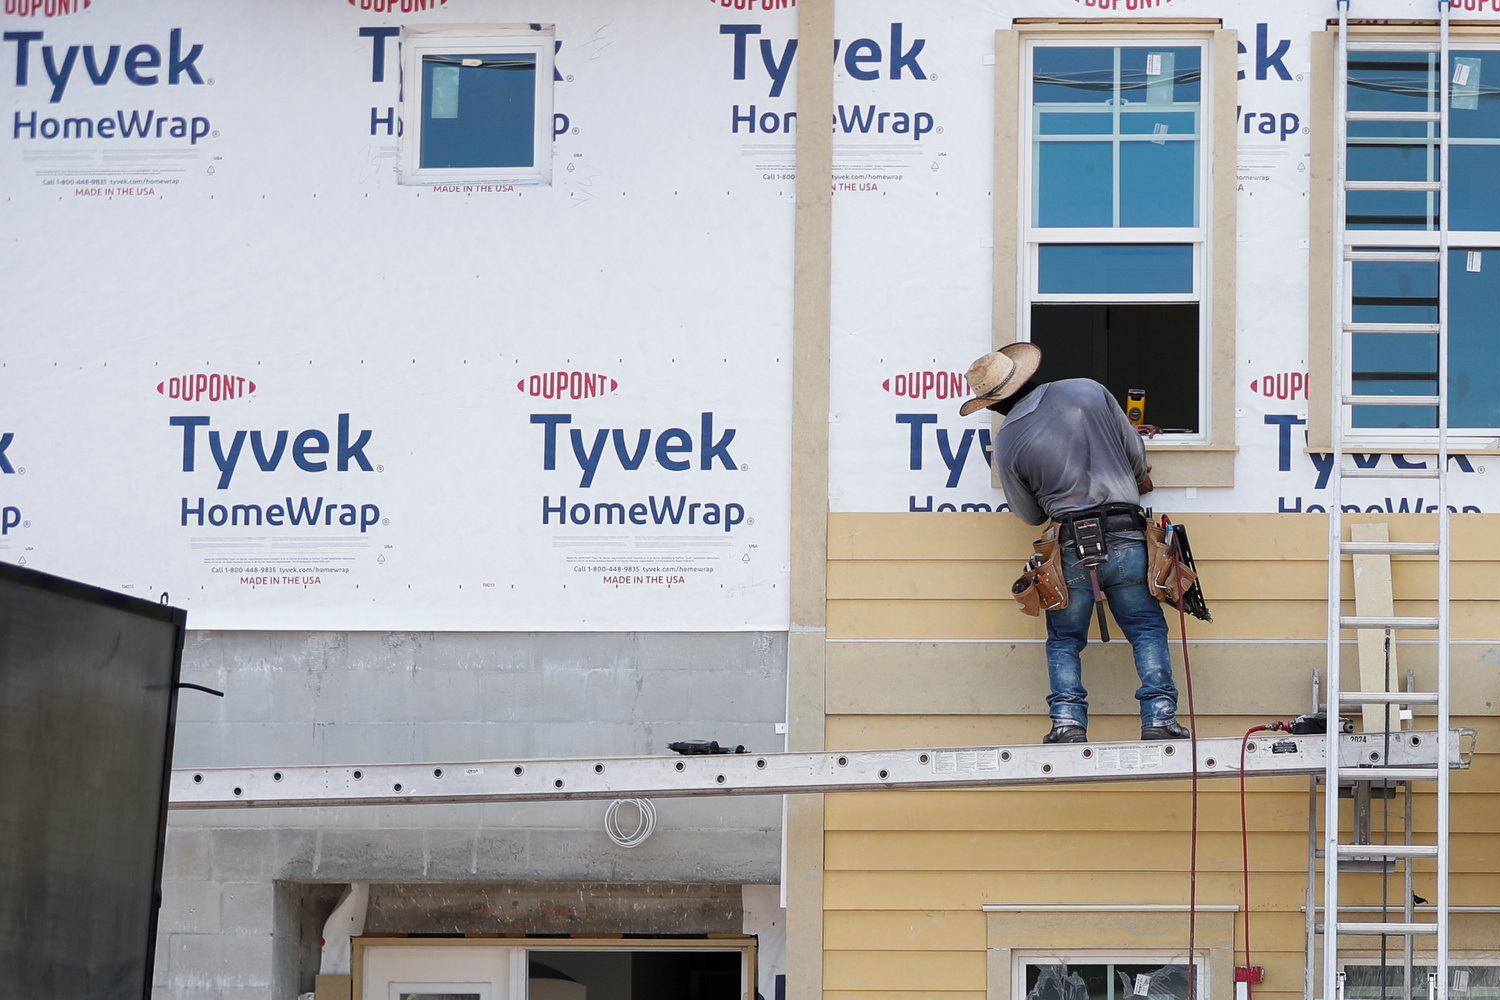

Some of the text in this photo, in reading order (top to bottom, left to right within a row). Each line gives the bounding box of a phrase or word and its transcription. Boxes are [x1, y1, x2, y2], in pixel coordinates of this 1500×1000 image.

[3, 28, 204, 103] Tyvek
[720, 23, 927, 97] Tyek
[14, 110, 210, 144] HomeWrap
[732, 105, 933, 140] HoWrap
[43, 177, 179, 186] Call 1-800-448-9835 tyvek.com/homewrap
[76, 187, 154, 196] MADE IN THE USA
[839, 183, 856, 191] THE
[859, 183, 878, 191] USA
[169, 374, 245, 402] DUPONT
[530, 371, 607, 399] DUPONT
[170, 413, 374, 489] Tyvek
[530, 412, 738, 488] Tyvek
[181, 497, 380, 533] HomeWrap
[543, 496, 744, 532] HomeWrap
[211, 566, 349, 574] Call 1-800-448-9835 tyvek.com/homewrap
[241, 576, 321, 584] MADE IN THE USA
[574, 565, 714, 573] Call 1-800-448-9835 tyvek.com/homewrap
[604, 575, 685, 584] MADE IN THE USA
